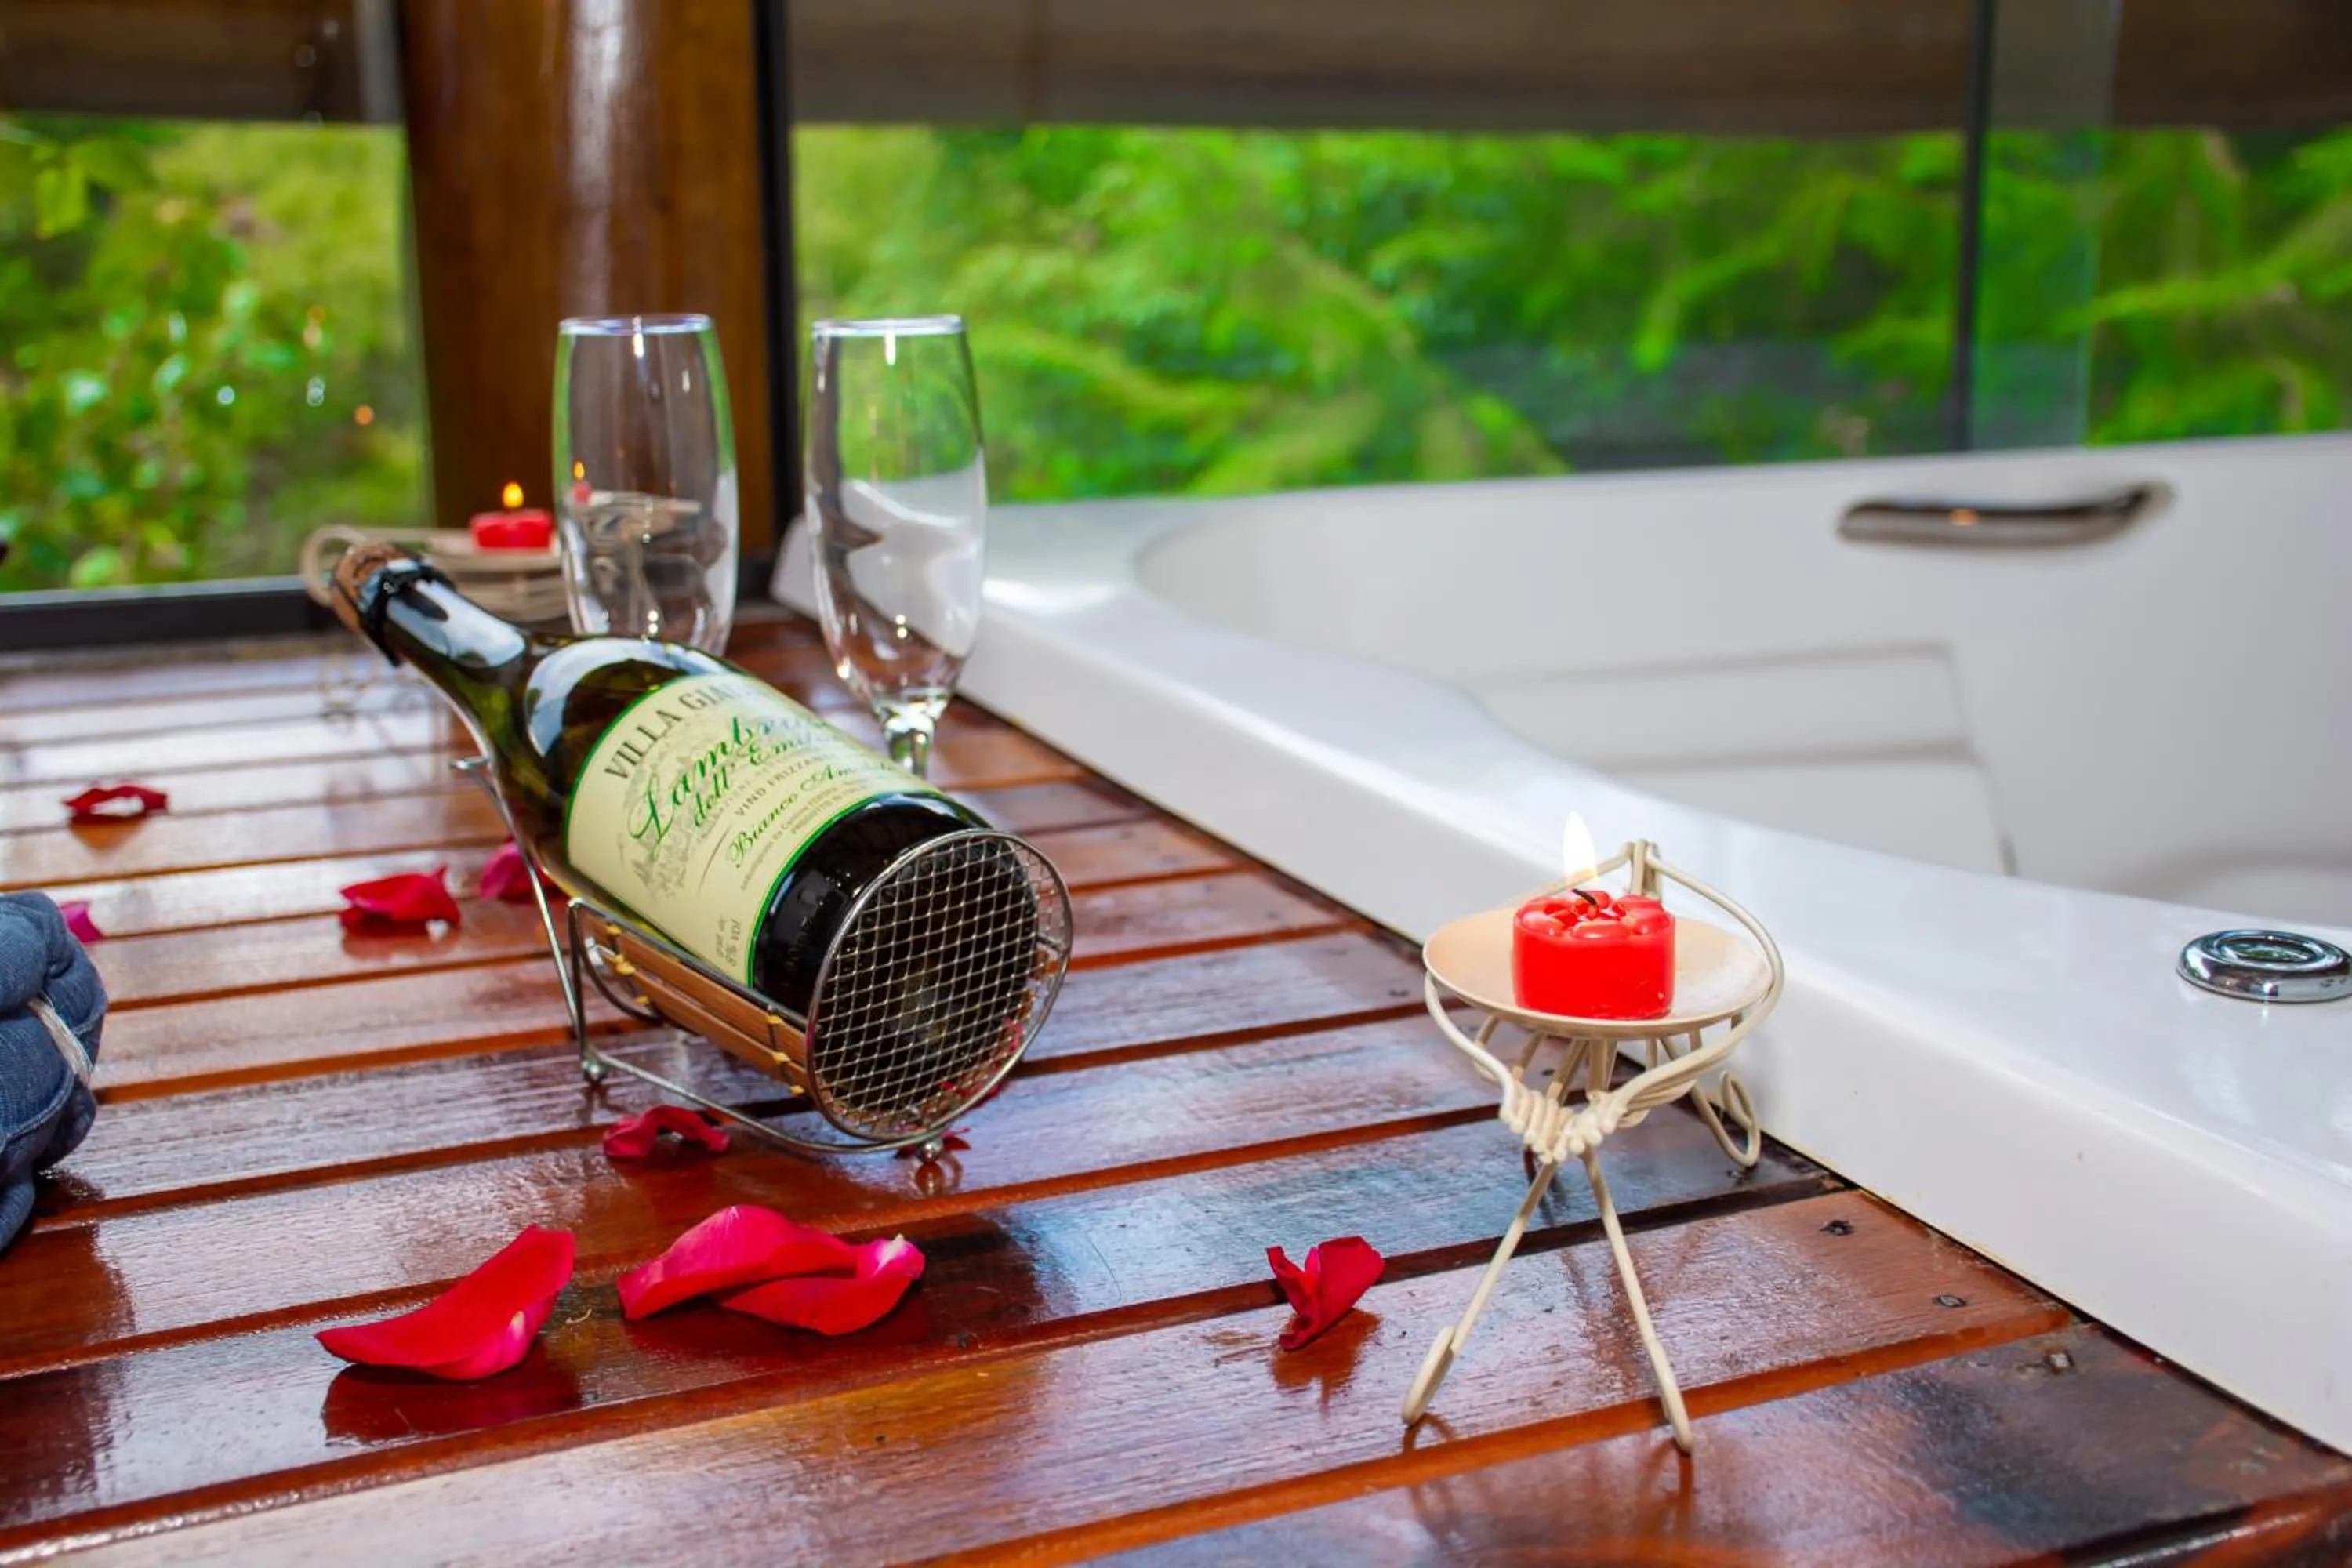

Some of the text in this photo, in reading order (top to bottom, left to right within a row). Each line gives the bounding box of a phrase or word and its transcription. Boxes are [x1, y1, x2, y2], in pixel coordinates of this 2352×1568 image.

[604, 710, 682, 779] VILLA
[725, 792, 798, 869] Bianco
[734, 786, 767, 817] VINO
